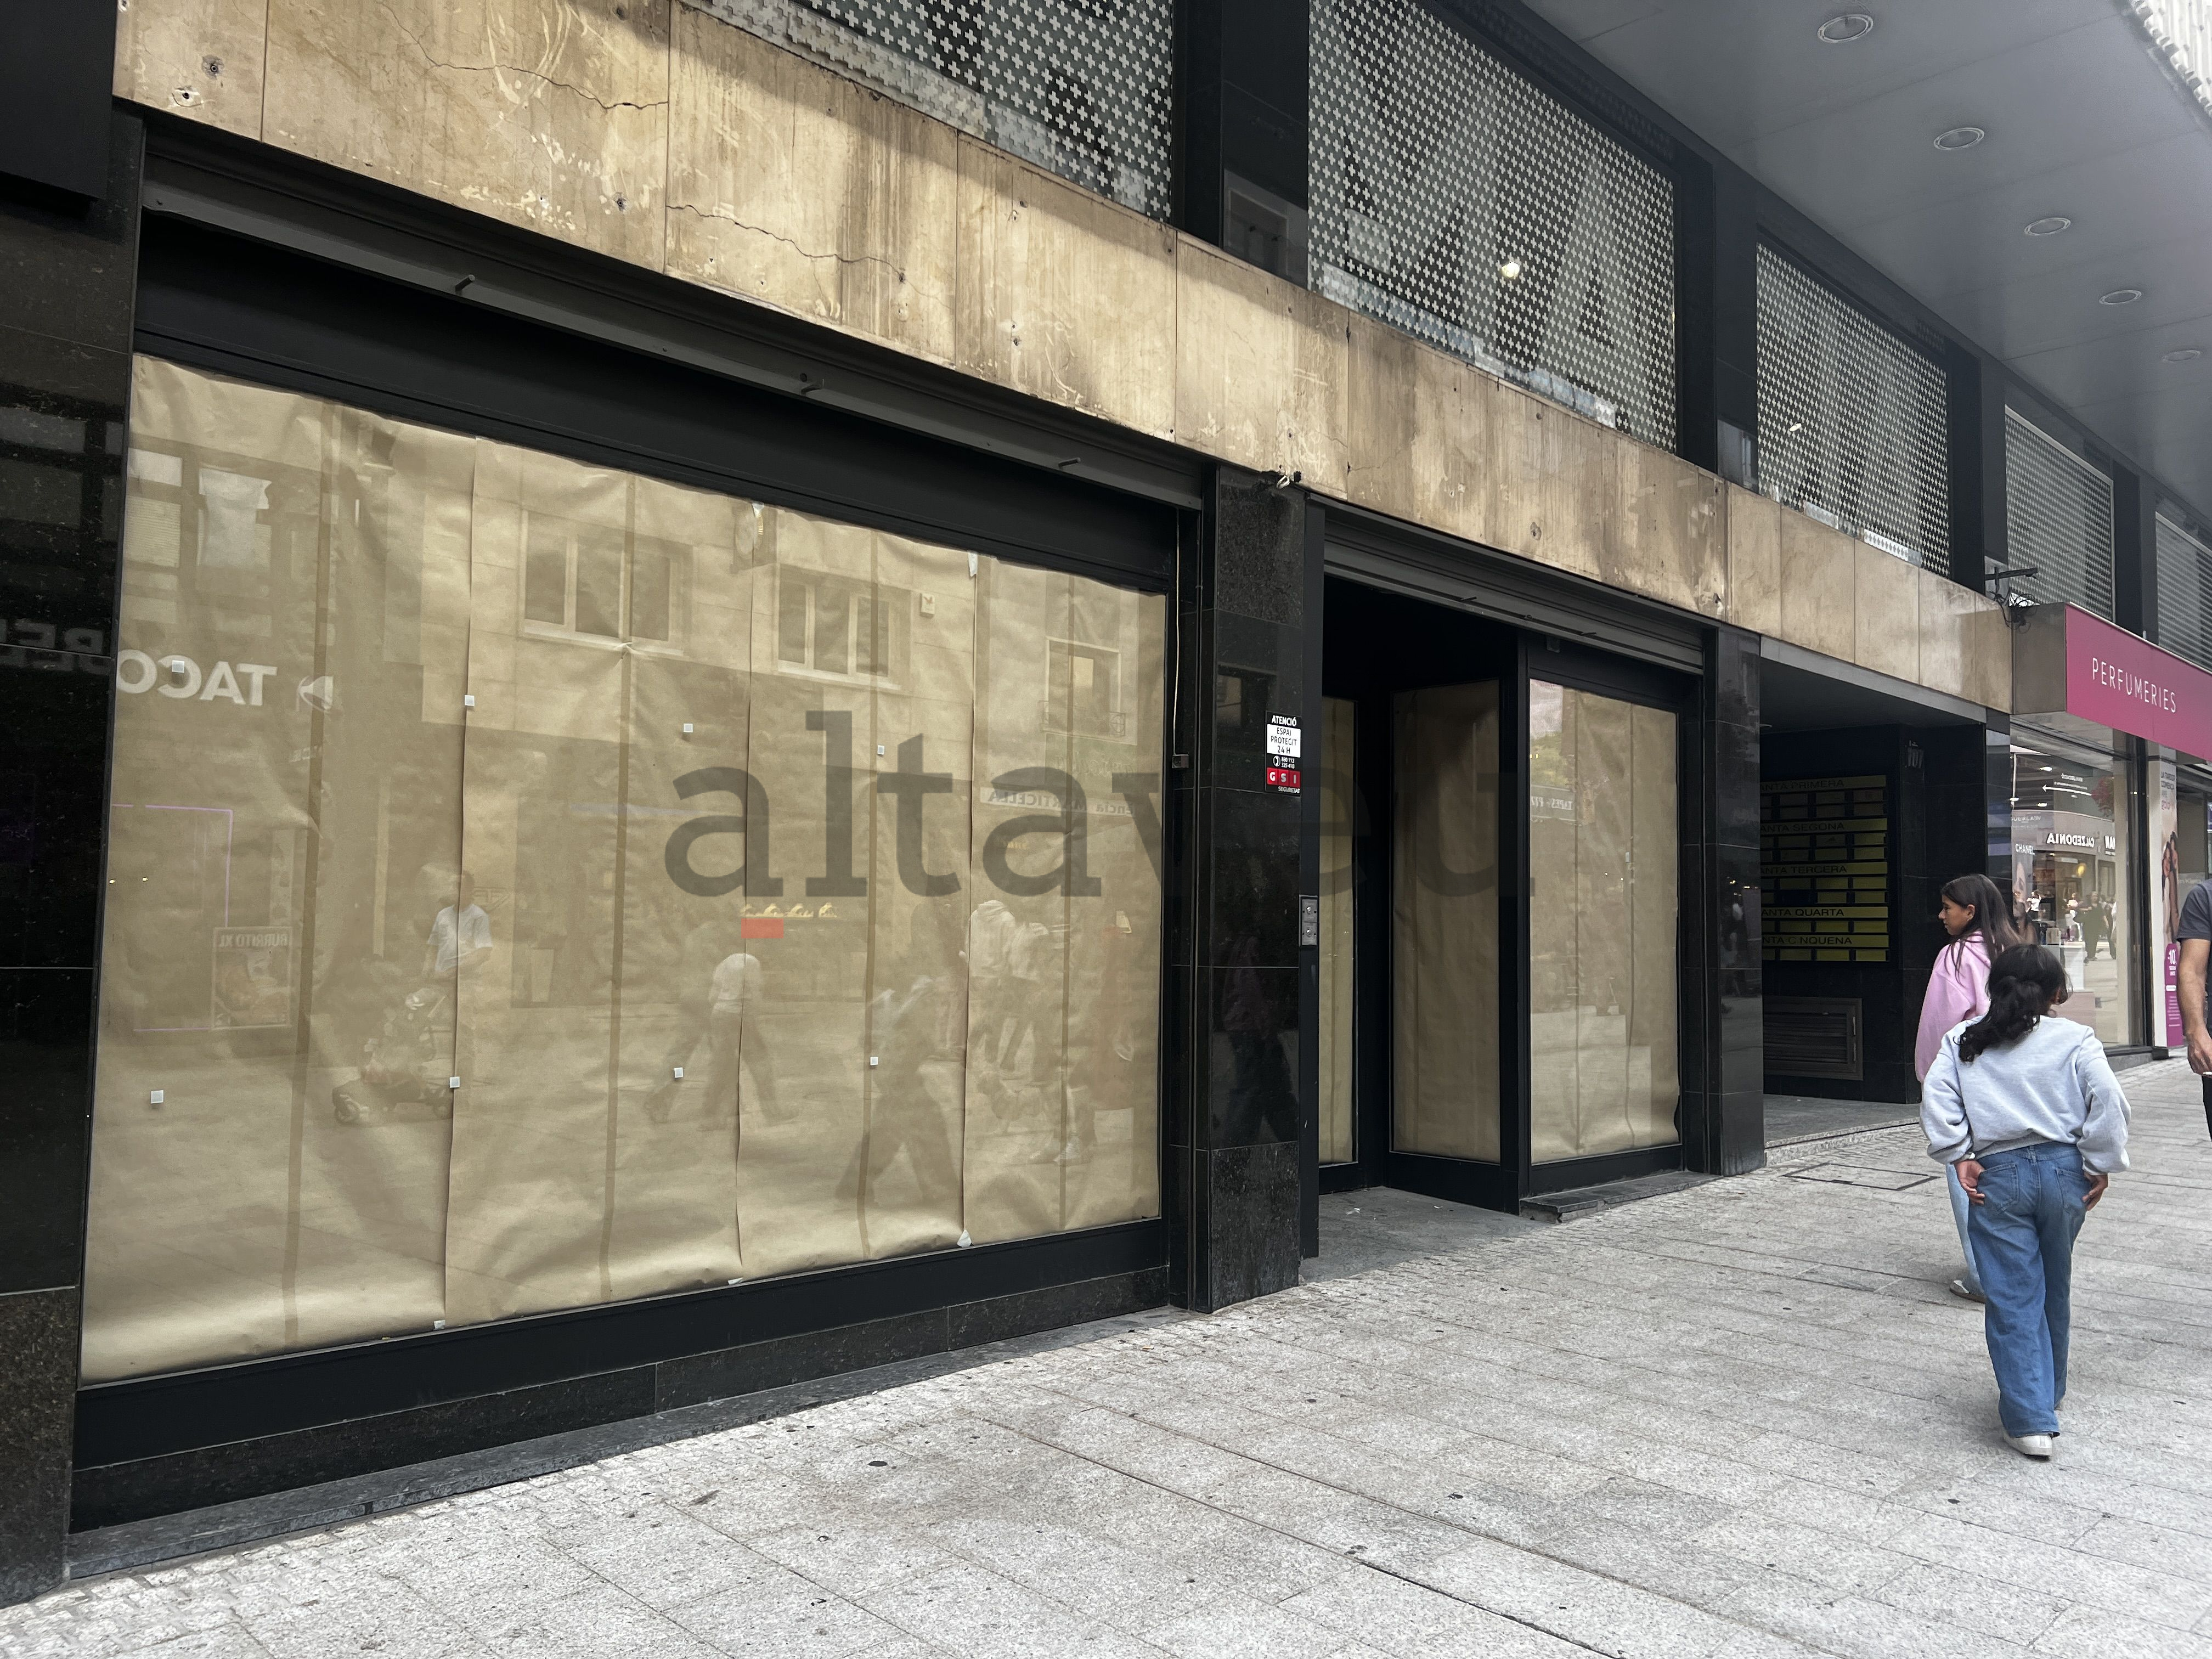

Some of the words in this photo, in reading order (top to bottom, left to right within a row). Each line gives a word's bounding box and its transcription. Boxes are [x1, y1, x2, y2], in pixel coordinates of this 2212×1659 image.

[2092, 657, 2177, 713] PERFUMERIES
[1271, 715, 1297, 727] ATENCIÓ
[1277, 727, 1291, 736] ESPAI
[1271, 736, 1297, 746] PROTEGIT
[1277, 746, 1285, 754] 24
[1269, 771, 1296, 784] GSI
[1791, 780, 1844, 790] PRIMERA
[1760, 825, 1789, 833] ANTA
[1793, 822, 1844, 831] SEGONA
[2015, 843, 2035, 855] CHANEL
[1760, 866, 1787, 874] ANTA
[1791, 865, 1847, 874] TERCERA
[1761, 909, 1791, 917] ANTA
[1795, 909, 1844, 917] QUARTA
[1762, 936, 1785, 944] NTA
